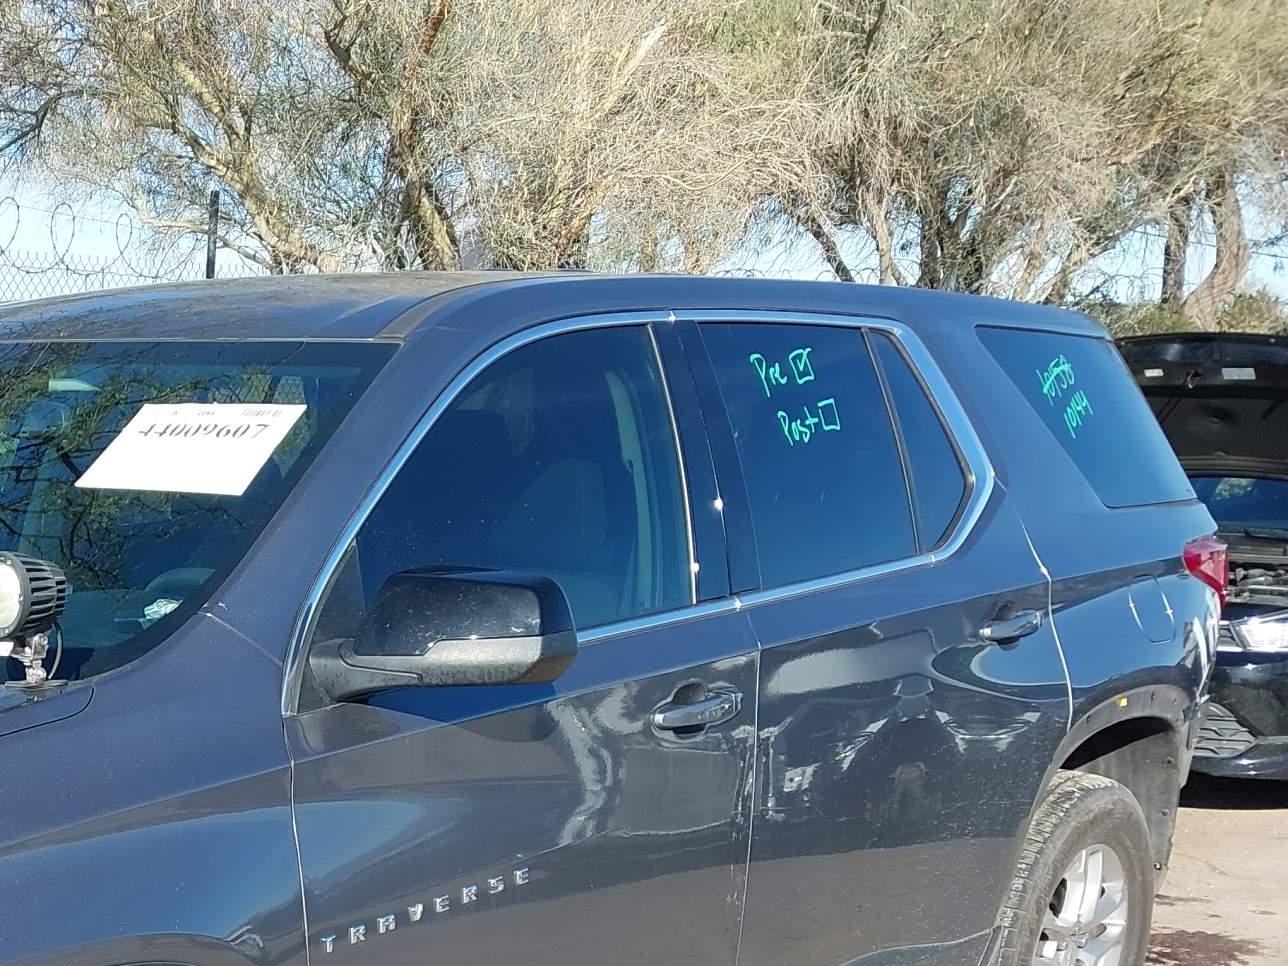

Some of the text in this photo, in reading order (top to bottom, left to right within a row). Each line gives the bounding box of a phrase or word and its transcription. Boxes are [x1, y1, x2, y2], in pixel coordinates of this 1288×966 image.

[750, 353, 788, 398] Pre
[138, 423, 270, 439] 44009607
[777, 406, 819, 446] Post
[320, 867, 529, 953] TRAVERSE
